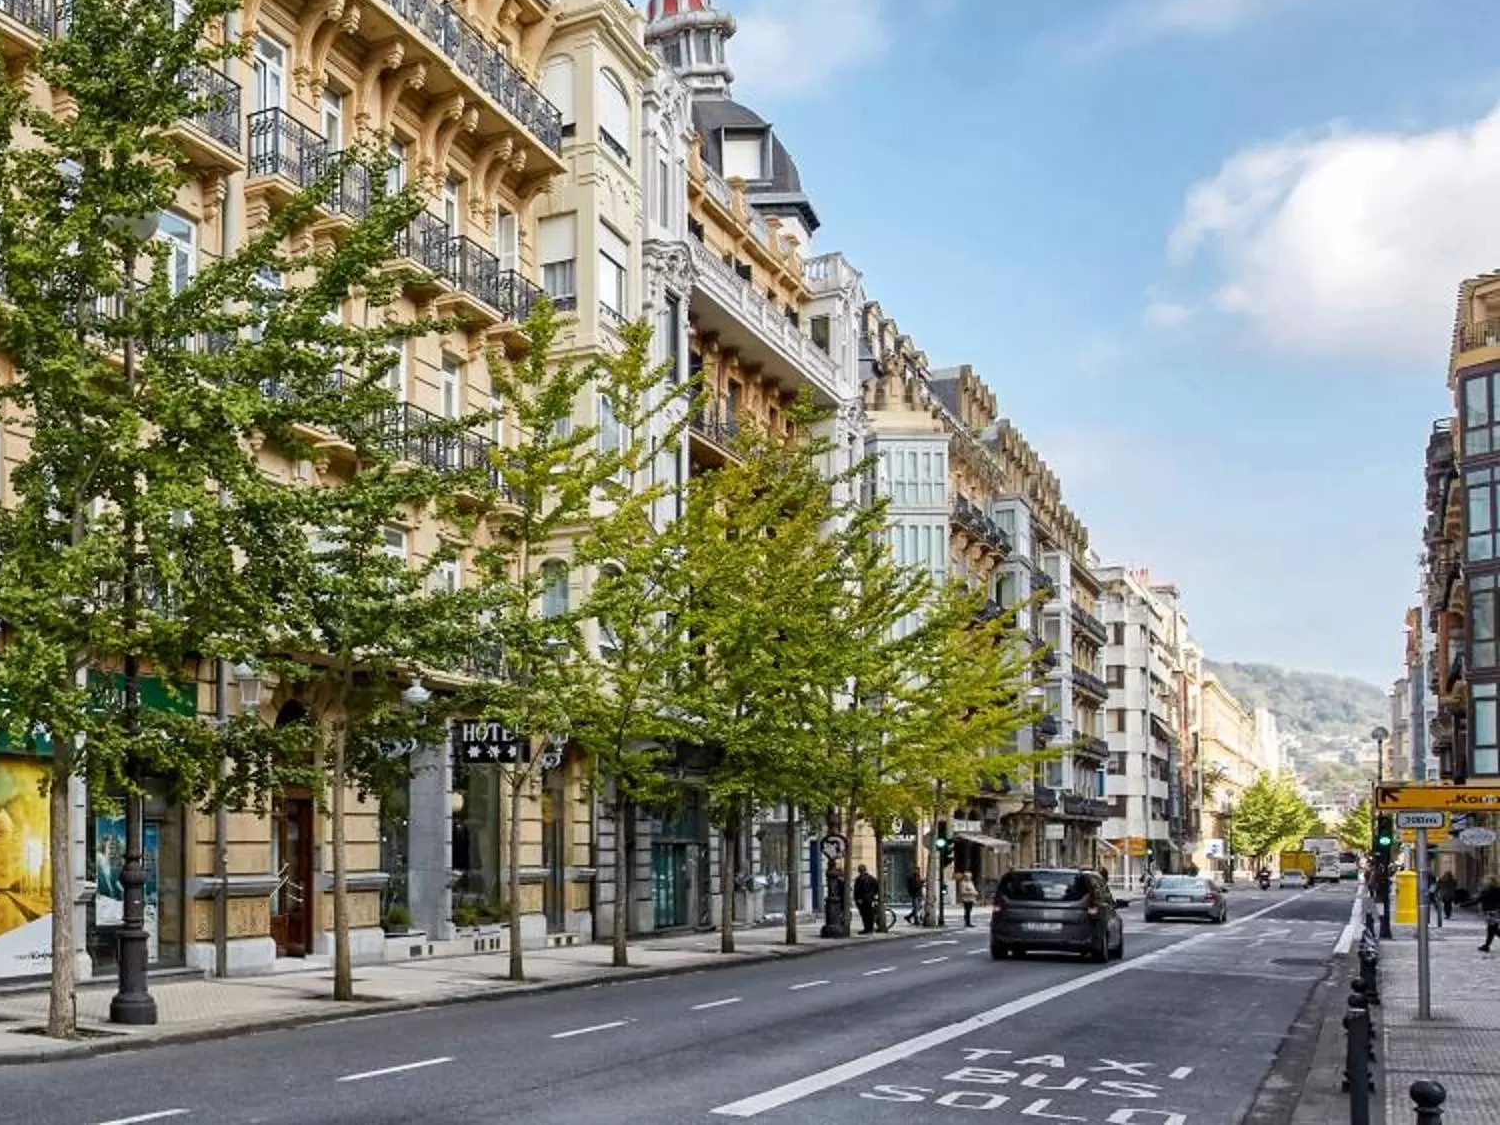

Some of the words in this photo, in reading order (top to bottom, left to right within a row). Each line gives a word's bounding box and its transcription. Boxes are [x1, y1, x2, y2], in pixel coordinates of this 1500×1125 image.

[462, 723, 520, 742] HOTE
[961, 1047, 1194, 1080] TAXI
[942, 1066, 1164, 1098] BUS
[859, 1083, 1188, 1125] SOLO
